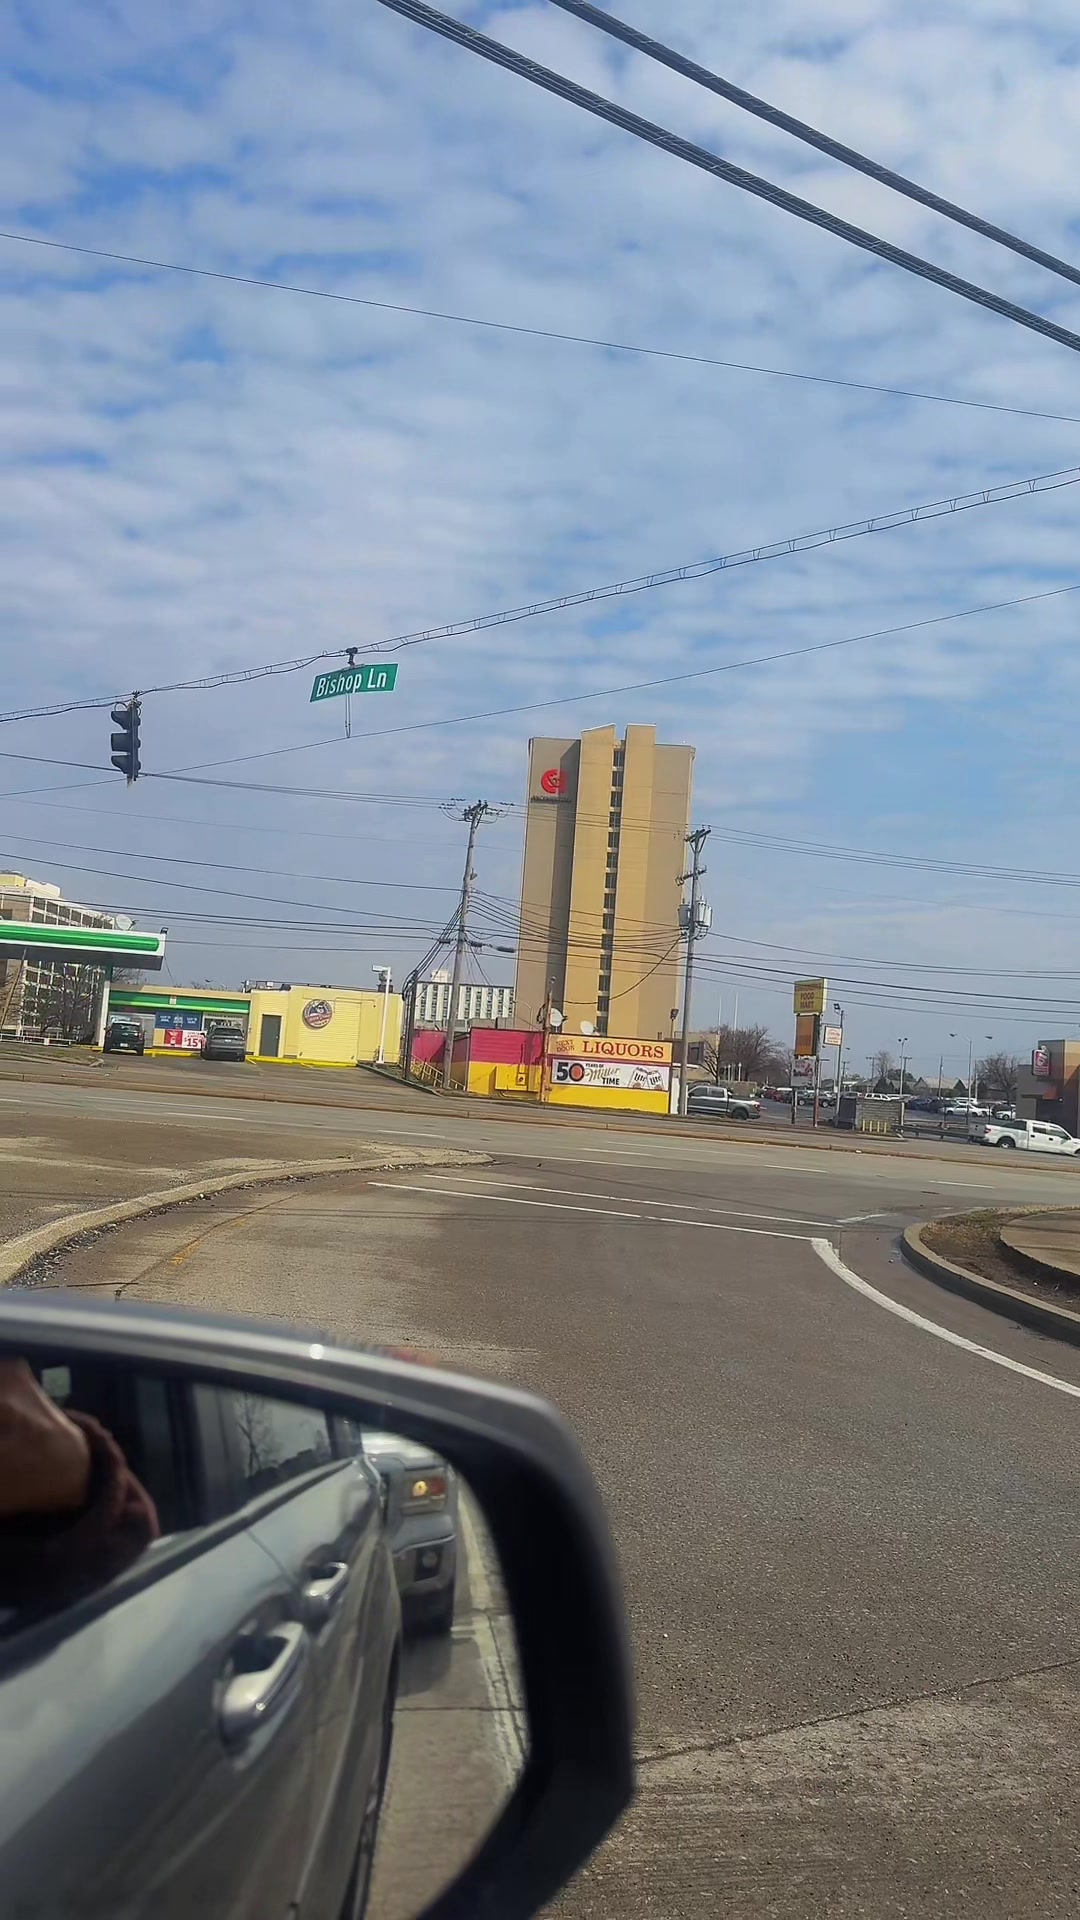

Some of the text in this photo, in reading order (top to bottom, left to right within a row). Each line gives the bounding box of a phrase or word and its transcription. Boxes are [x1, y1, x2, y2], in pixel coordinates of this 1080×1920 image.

[316, 668, 387, 697] Bishop Ln
[800, 992, 815, 1001] FOOD
[583, 1041, 664, 1058] LIQUORS
[556, 1062, 585, 1082] 50
[585, 1067, 620, 1082] Miller
[602, 1077, 620, 1085] TIME
